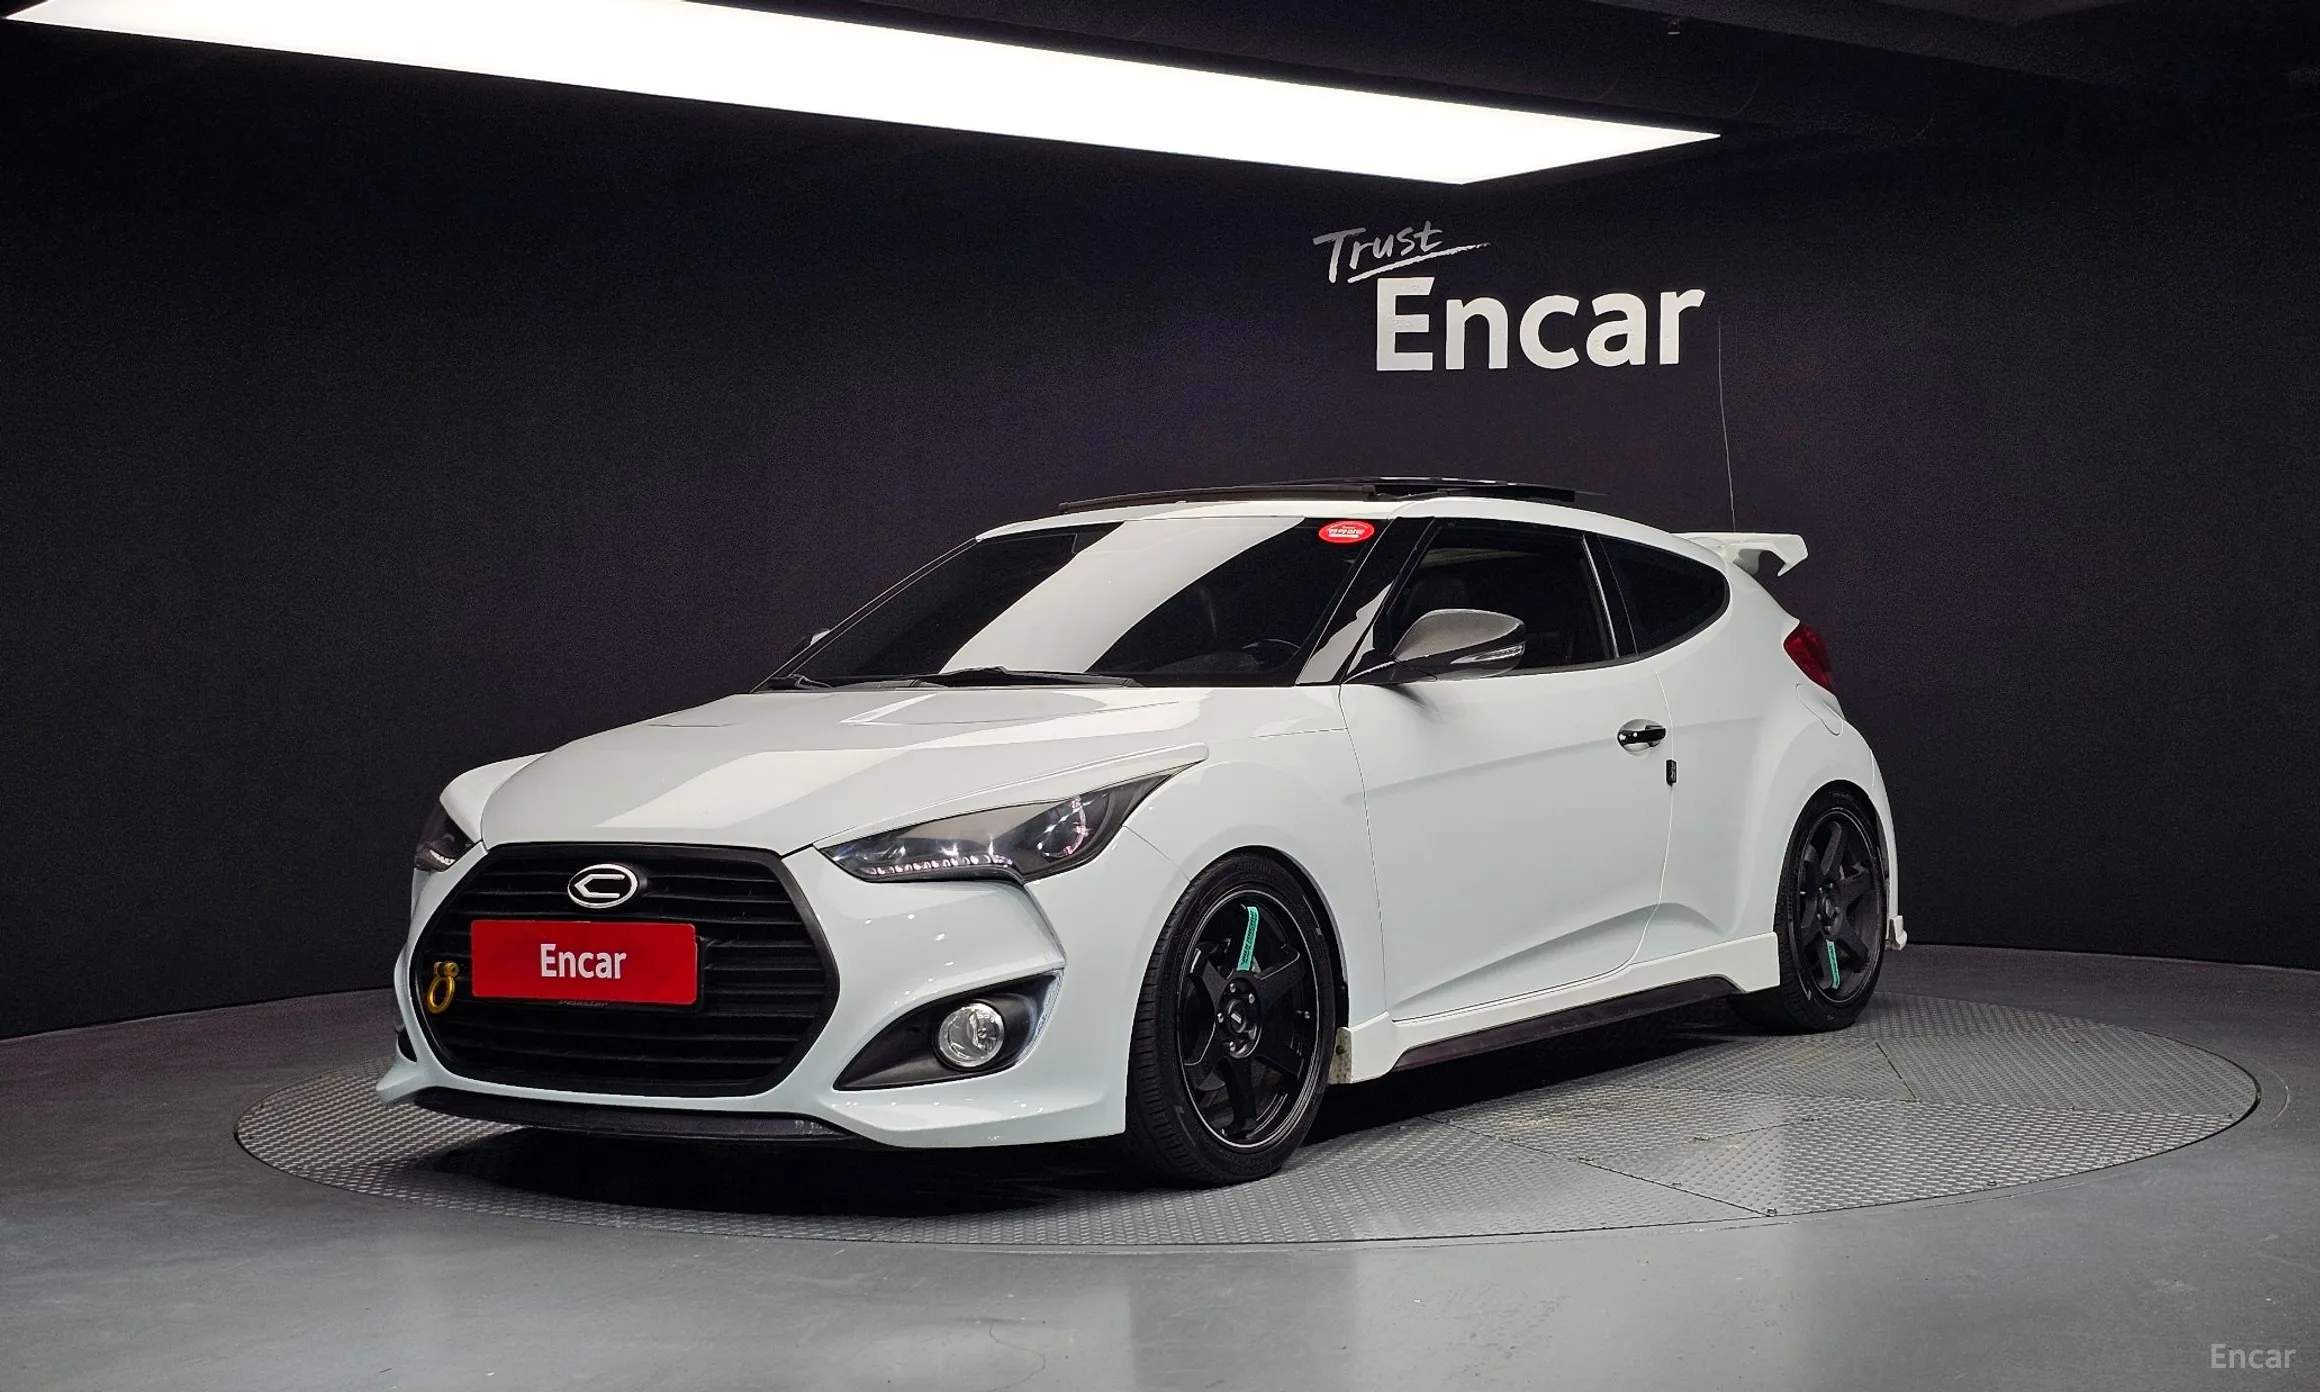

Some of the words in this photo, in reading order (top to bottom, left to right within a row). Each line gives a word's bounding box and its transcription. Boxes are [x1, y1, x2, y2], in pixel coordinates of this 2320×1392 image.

[1312, 220, 1443, 283] Trust
[1376, 276, 1706, 371] Encar
[540, 943, 627, 979] Encar
